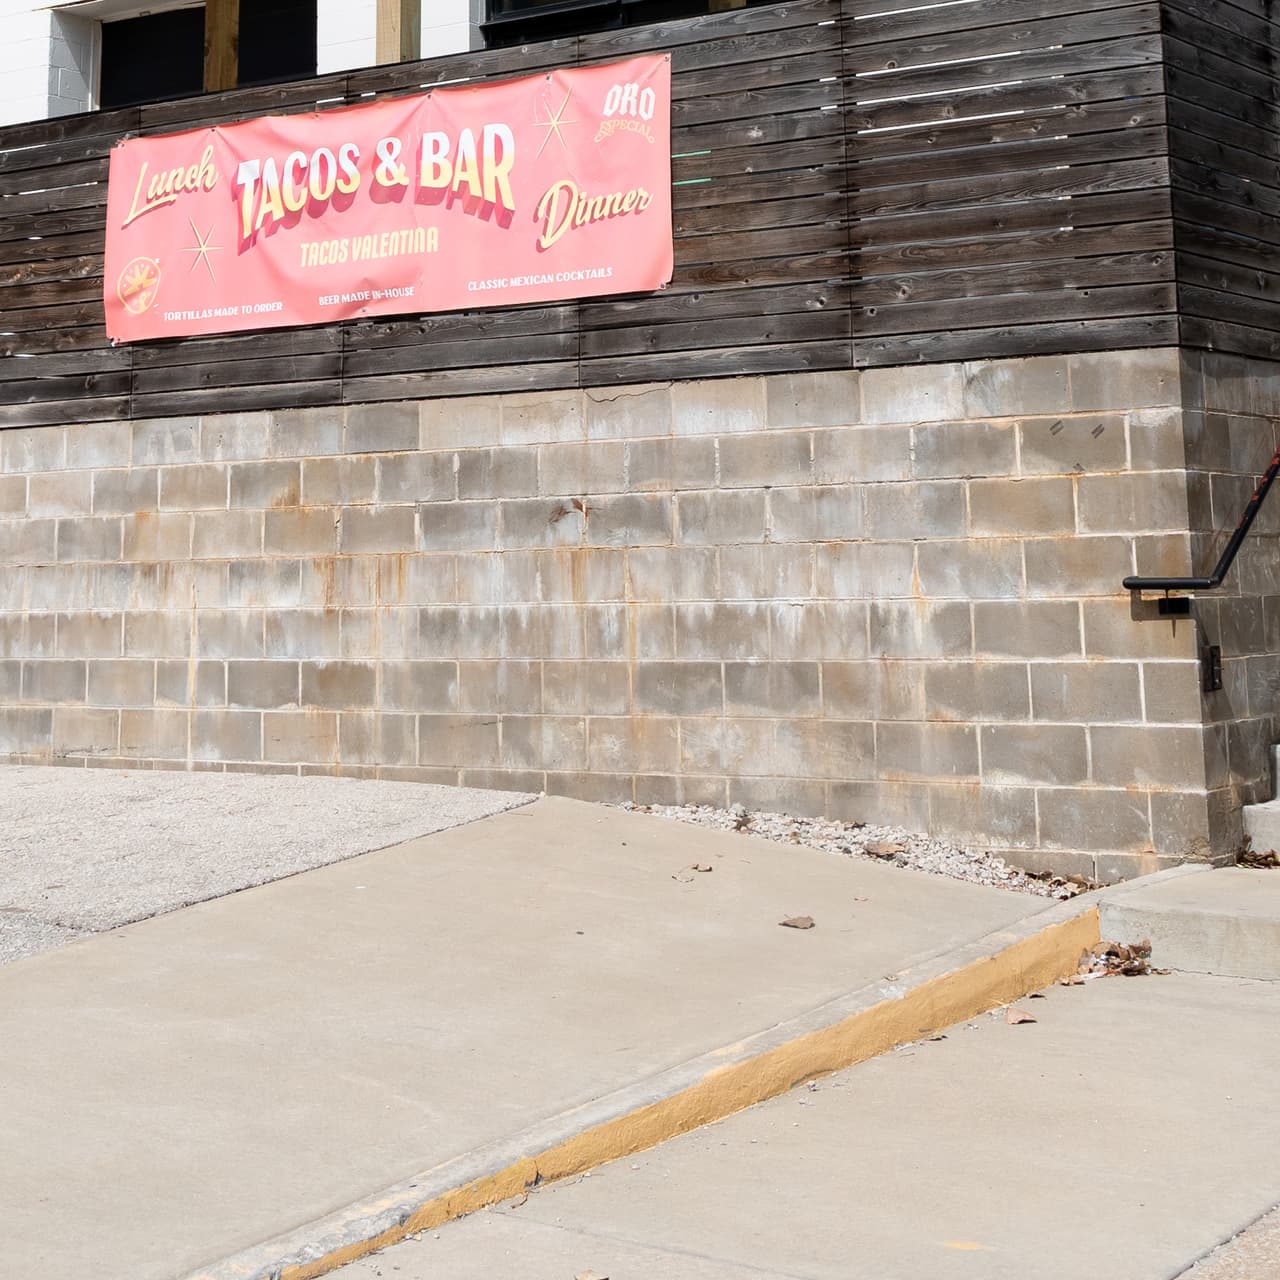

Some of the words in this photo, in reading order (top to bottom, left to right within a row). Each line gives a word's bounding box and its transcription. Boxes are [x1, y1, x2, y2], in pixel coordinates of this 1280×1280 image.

[603, 83, 656, 121] ORO
[122, 145, 219, 228] Lunch
[234, 142, 361, 245] TACOS
[373, 136, 410, 192] &
[418, 122, 516, 218] BAR
[536, 179, 654, 250] Dinner
[300, 238, 349, 268] TACOS
[351, 226, 439, 264] VALENTINA
[319, 293, 340, 306] BEER
[341, 290, 370, 303] MADE
[371, 286, 415, 301] IN-HOUSE
[467, 278, 509, 291] CLASSIC
[510, 274, 554, 287] MEXICAN
[555, 267, 613, 283] COCKTAILS
[163, 307, 213, 321] TORTILLAS
[214, 306, 239, 318] MADE
[241, 304, 253, 316] TO
[254, 301, 283, 313] ORDER
